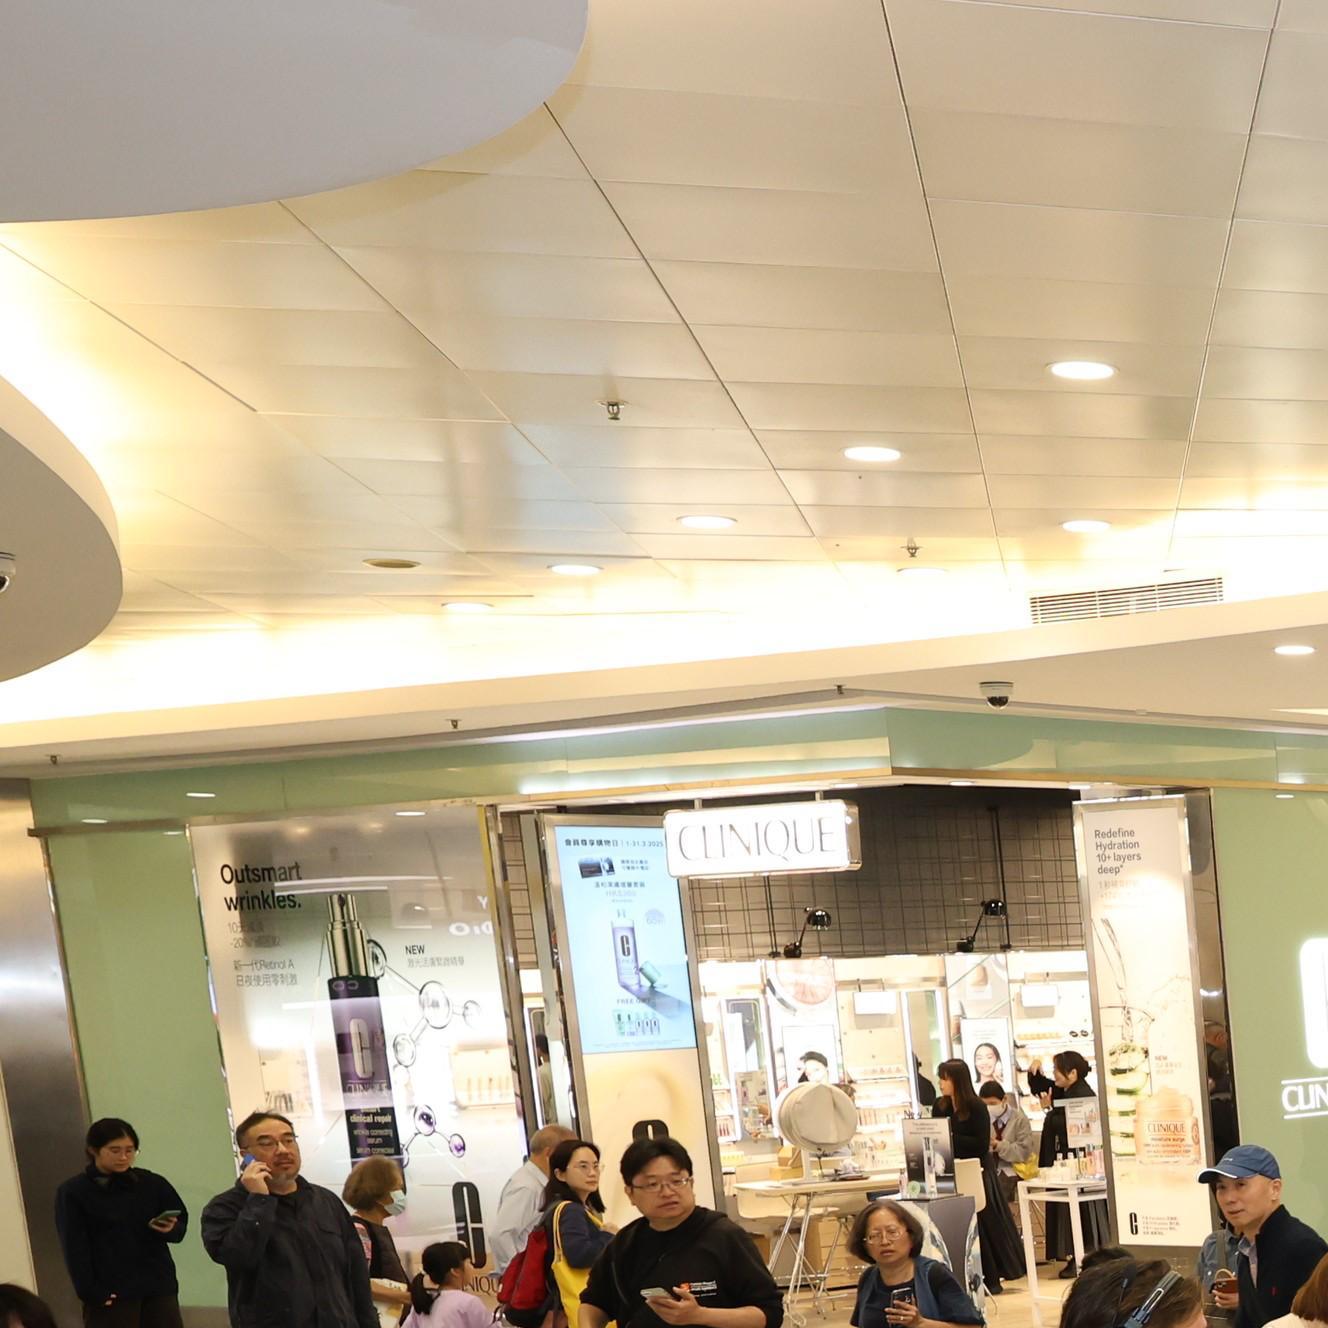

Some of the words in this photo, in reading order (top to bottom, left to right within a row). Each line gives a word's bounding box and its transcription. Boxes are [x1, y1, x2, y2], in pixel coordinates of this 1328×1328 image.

[679, 817, 836, 861] CLINIQUE
[1094, 828, 1135, 839] Redefine
[1095, 840, 1140, 852] Hydration
[1096, 853, 1111, 863] 10+
[1113, 852, 1142, 863] layers
[220, 861, 303, 885] Outsmart
[224, 889, 302, 912] wrinkles.
[405, 945, 425, 956] NEW
